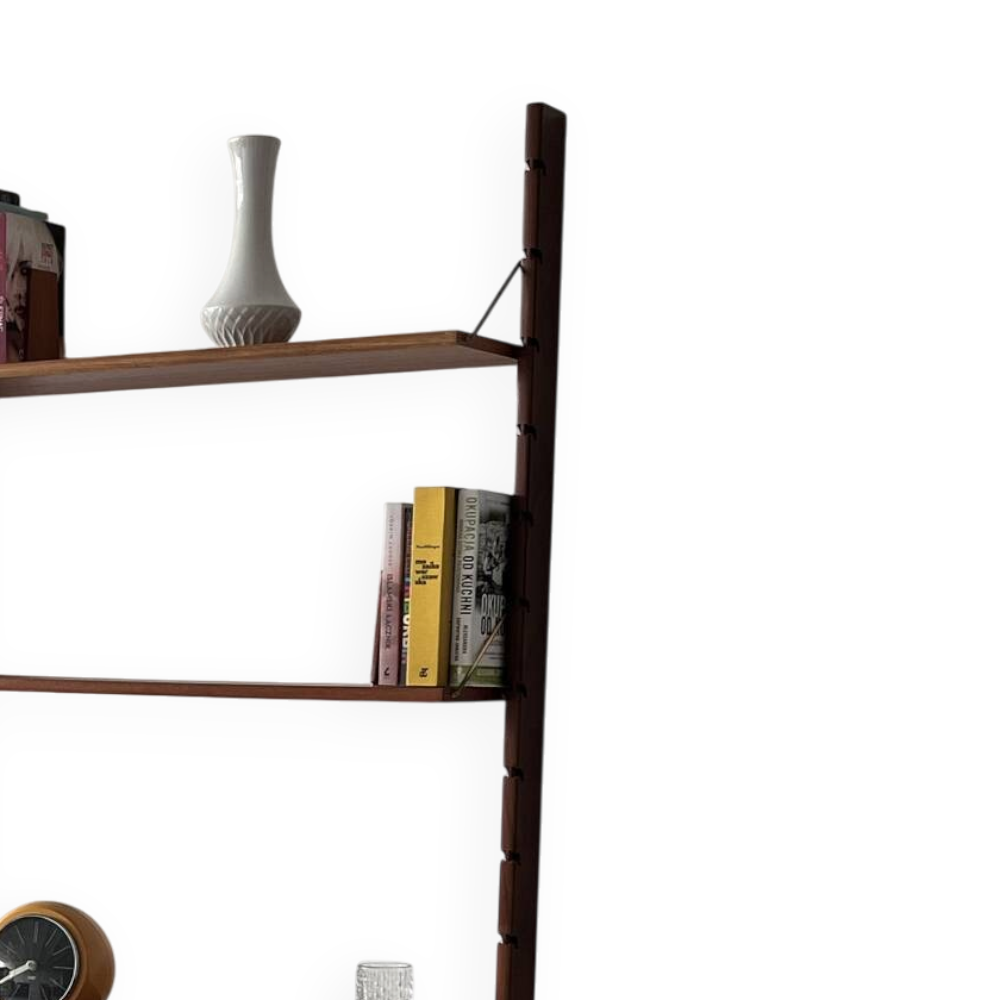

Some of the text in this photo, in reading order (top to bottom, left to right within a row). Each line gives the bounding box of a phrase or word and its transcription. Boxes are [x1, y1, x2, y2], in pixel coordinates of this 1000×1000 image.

[460, 498, 477, 615] OKUPACJA OD KUCHNI
